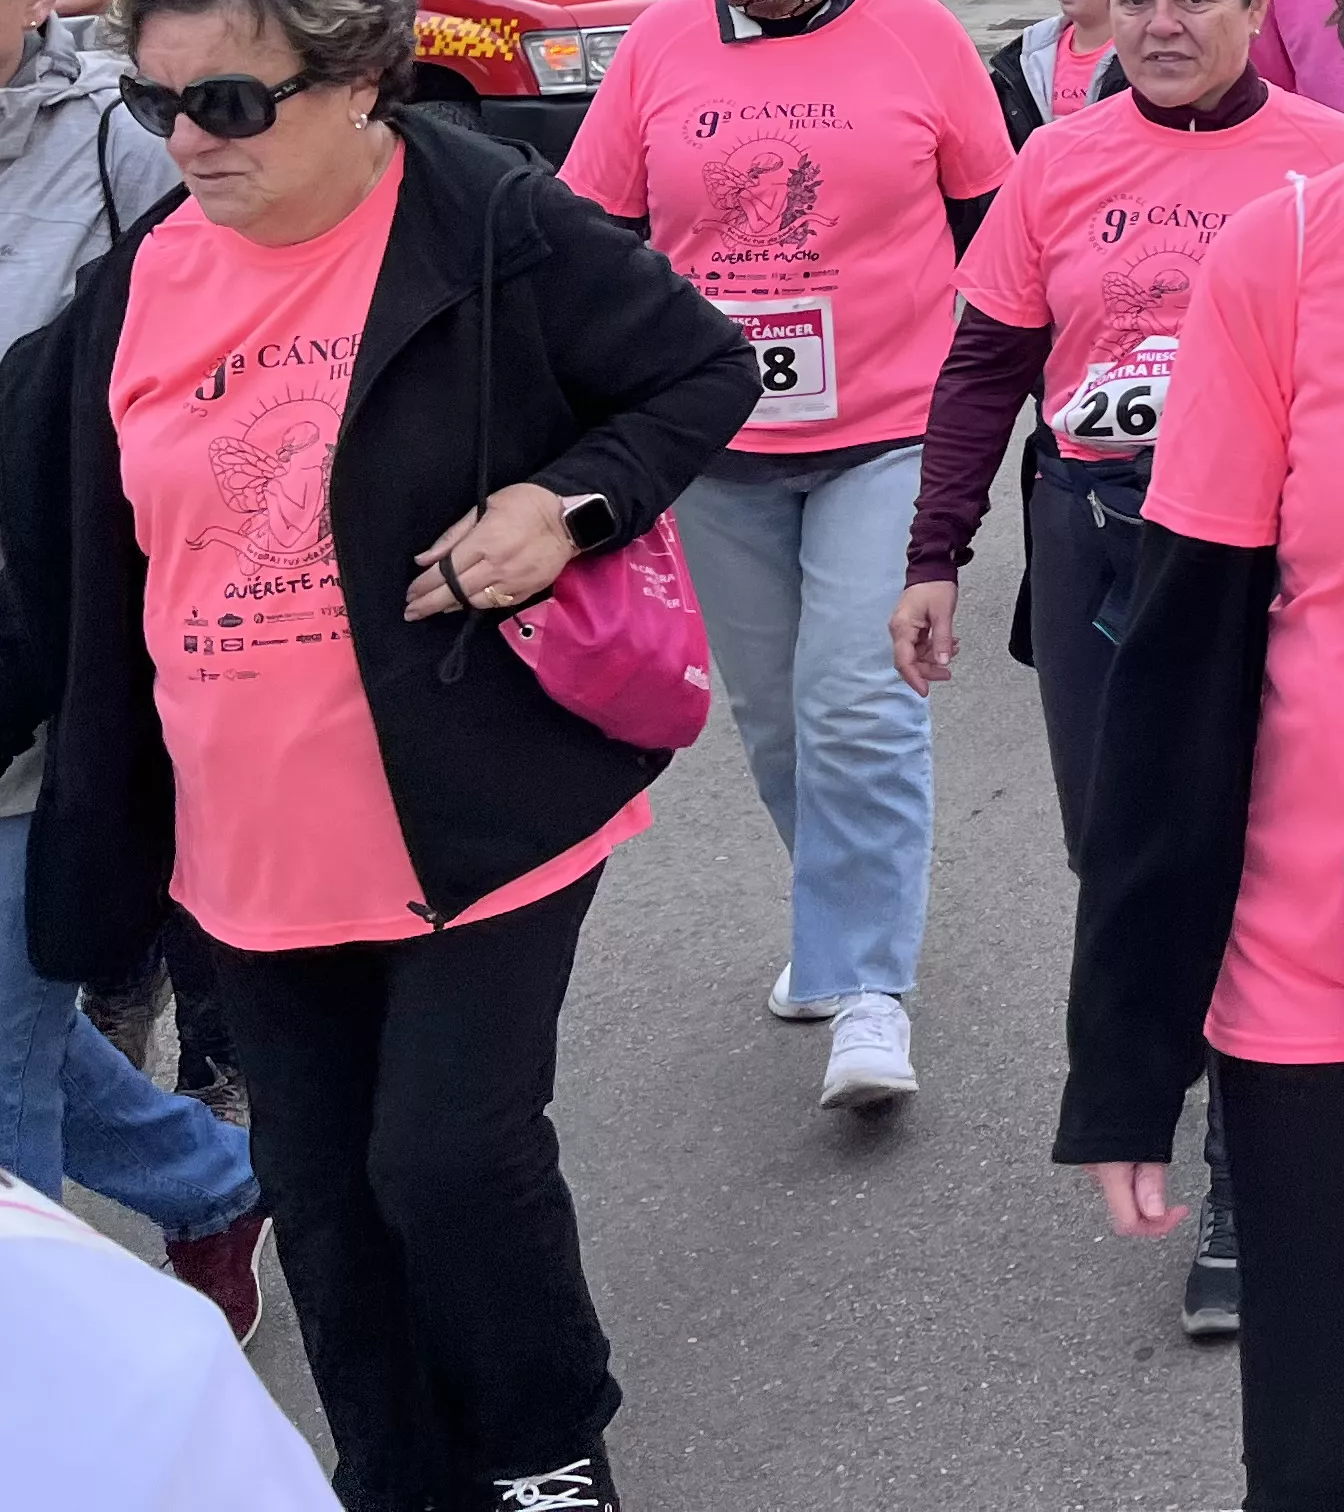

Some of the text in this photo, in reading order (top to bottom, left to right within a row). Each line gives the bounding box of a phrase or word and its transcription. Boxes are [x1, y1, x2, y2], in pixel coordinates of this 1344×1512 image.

[696, 101, 835, 138] 9ª CÁNCER
[789, 119, 853, 130] HUESCA
[1101, 208, 1140, 244] 9ª
[774, 250, 820, 263] MUCHO
[752, 324, 814, 339] CÁNCER
[257, 335, 363, 369] CÁNCE
[1136, 352, 1176, 363] HUESC
[1152, 363, 1170, 376] EL
[223, 573, 314, 600] QUIÉRETE
